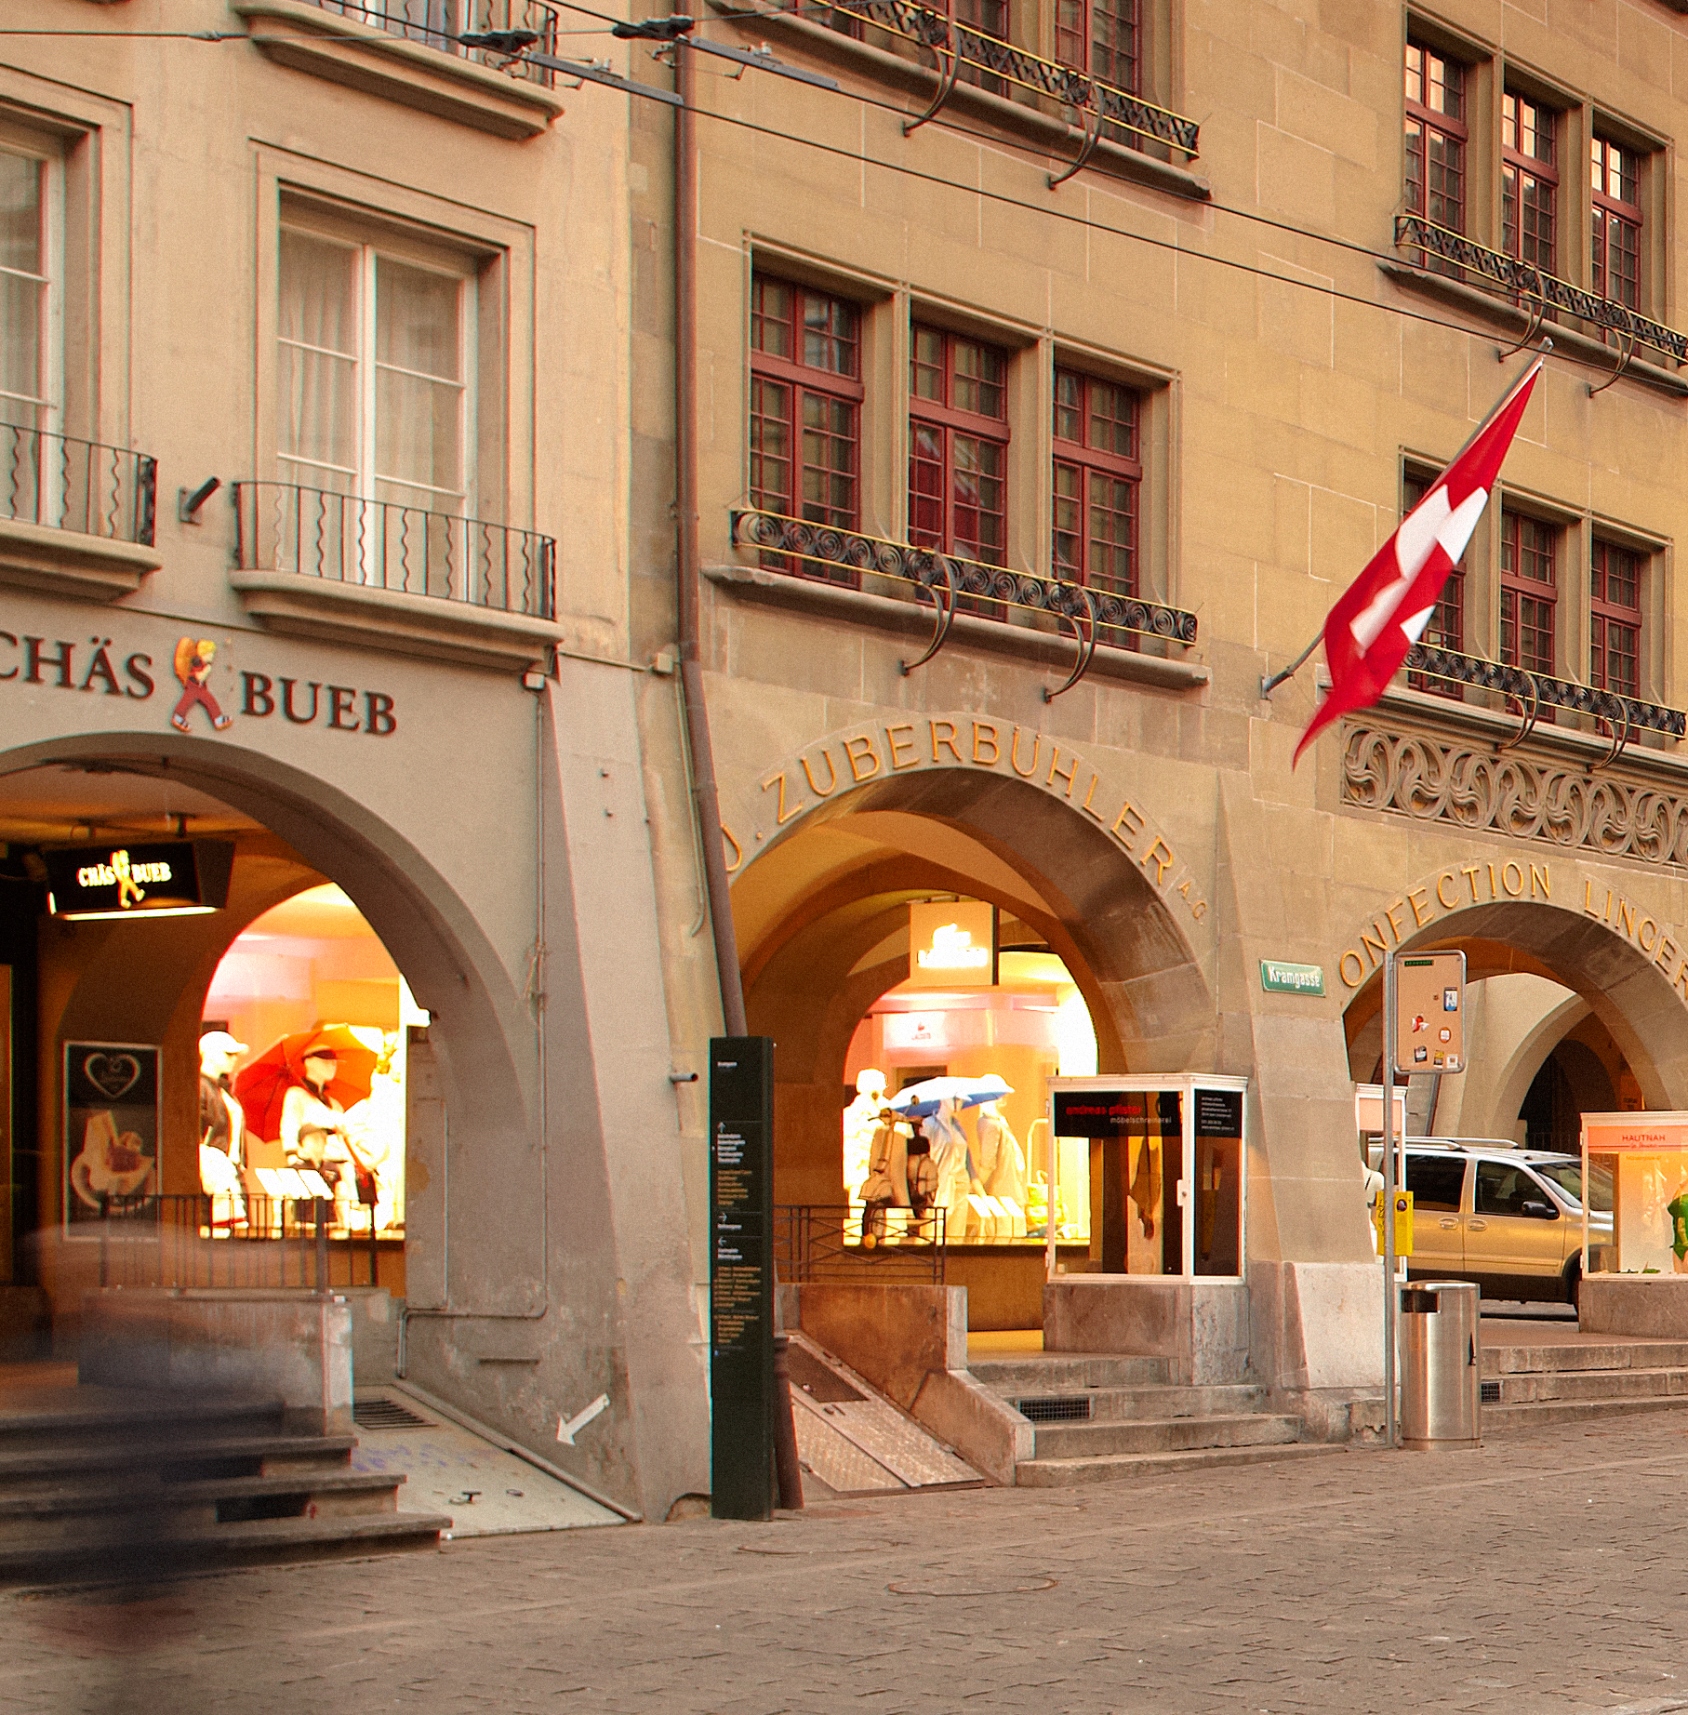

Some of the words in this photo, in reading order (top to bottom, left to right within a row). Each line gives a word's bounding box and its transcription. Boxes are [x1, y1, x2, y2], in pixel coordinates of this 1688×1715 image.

[241, 670, 398, 737] BUEB
[761, 719, 1174, 886] ZUBERBÜHLER
[78, 863, 117, 888] CHÄS
[131, 862, 172, 884] BUEB
[1268, 965, 1321, 989] Kramgasse
[1621, 1134, 1666, 1143] HAUTNAH
